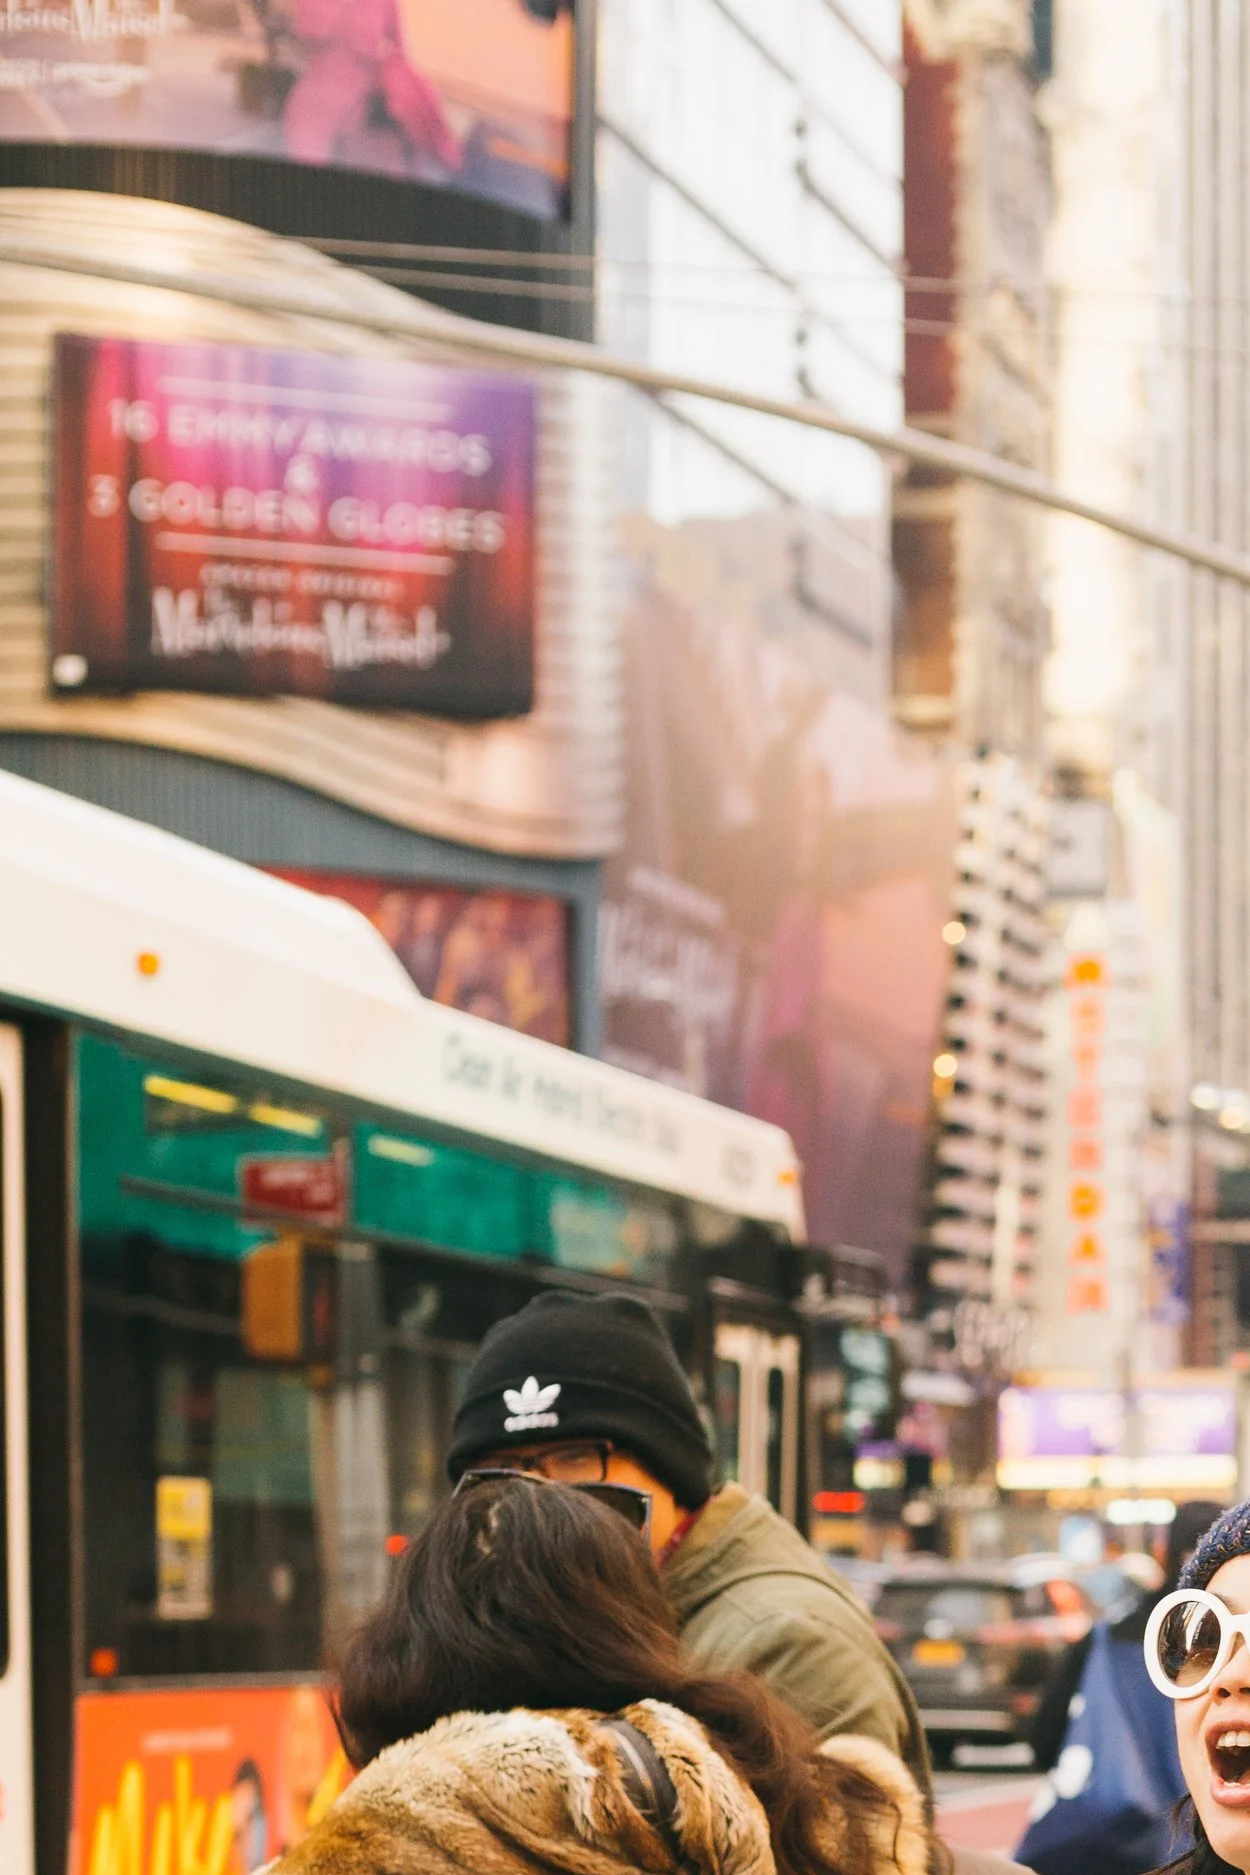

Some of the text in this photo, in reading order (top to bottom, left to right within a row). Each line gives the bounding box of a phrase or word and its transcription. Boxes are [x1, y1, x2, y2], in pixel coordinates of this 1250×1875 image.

[299, 416, 492, 477] AWARDS
[128, 478, 320, 534] GOLDEN
[328, 496, 506, 554] GLOBES
